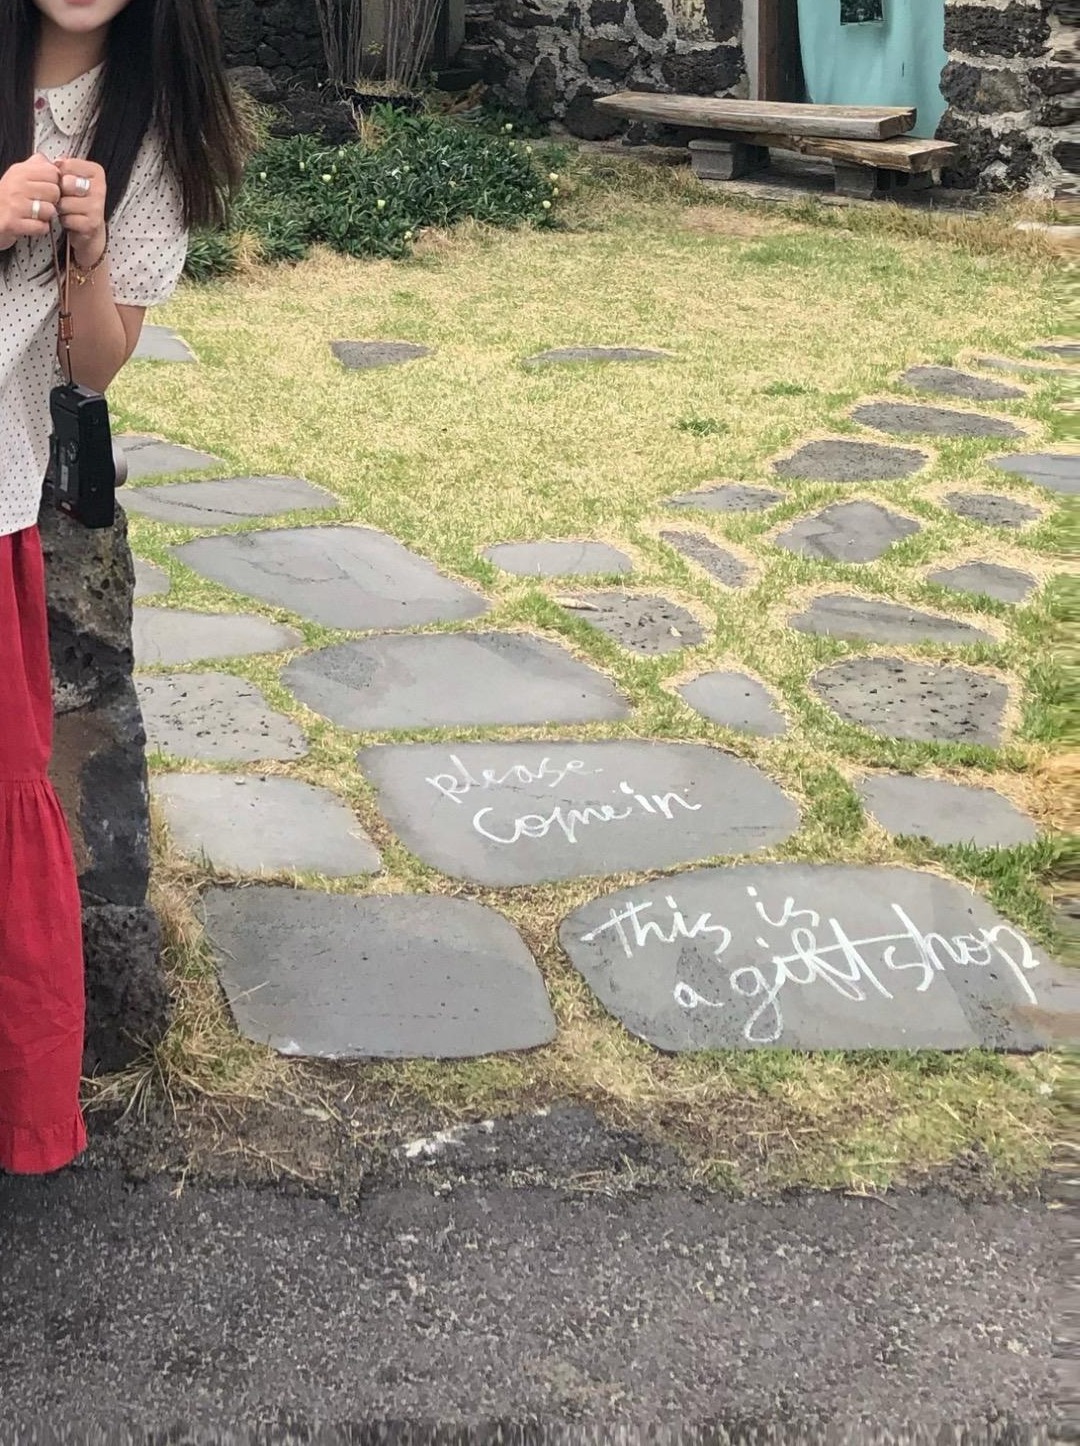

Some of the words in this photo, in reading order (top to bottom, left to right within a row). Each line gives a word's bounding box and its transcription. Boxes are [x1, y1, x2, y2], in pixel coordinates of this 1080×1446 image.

[746, 886, 819, 927] is
[673, 981, 723, 1009] a
[729, 918, 900, 1043] gift
[884, 903, 1040, 1005] shop
